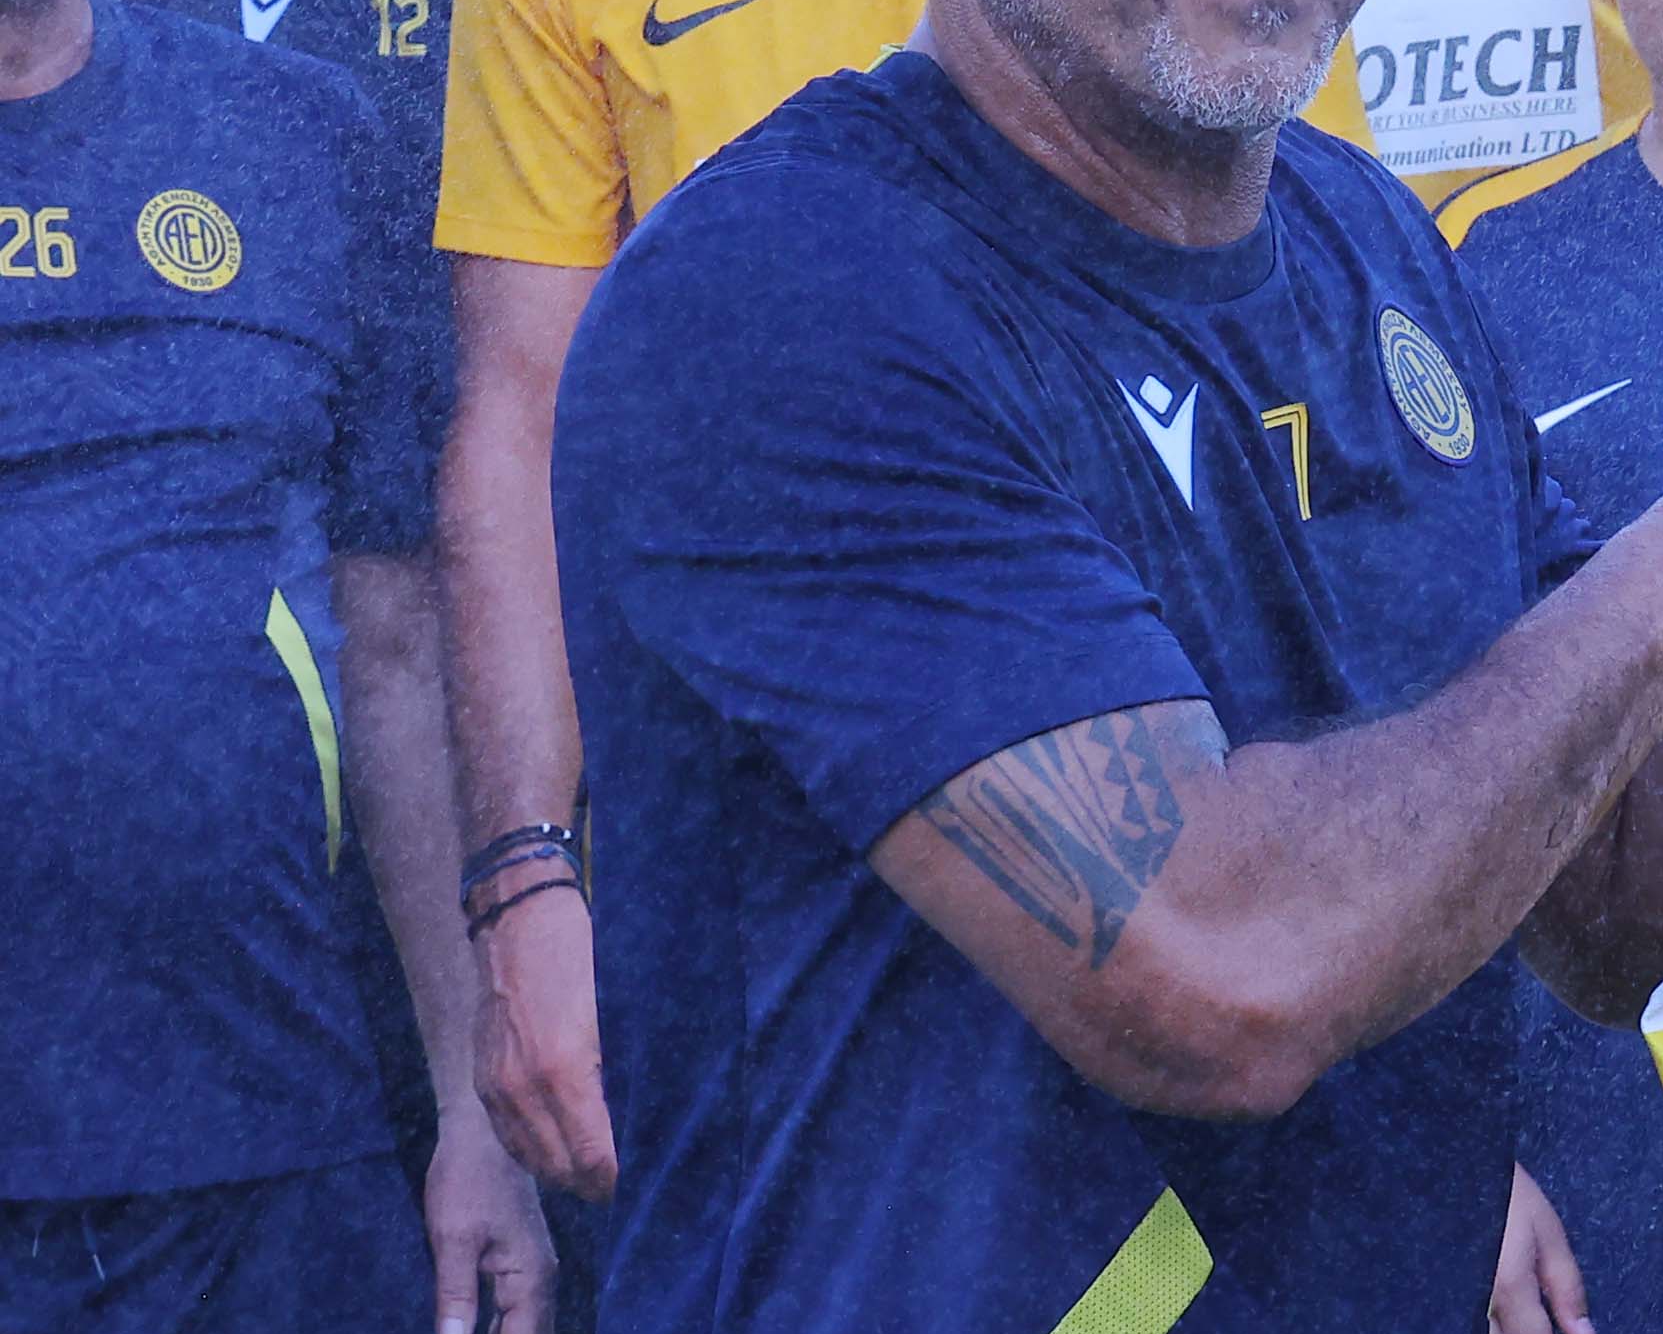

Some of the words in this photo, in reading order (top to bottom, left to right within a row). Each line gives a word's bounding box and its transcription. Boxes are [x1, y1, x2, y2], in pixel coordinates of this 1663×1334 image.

[1521, 129, 1576, 154] LTD
[0, 206, 78, 278] 26
[1261, 403, 1313, 522] 7
